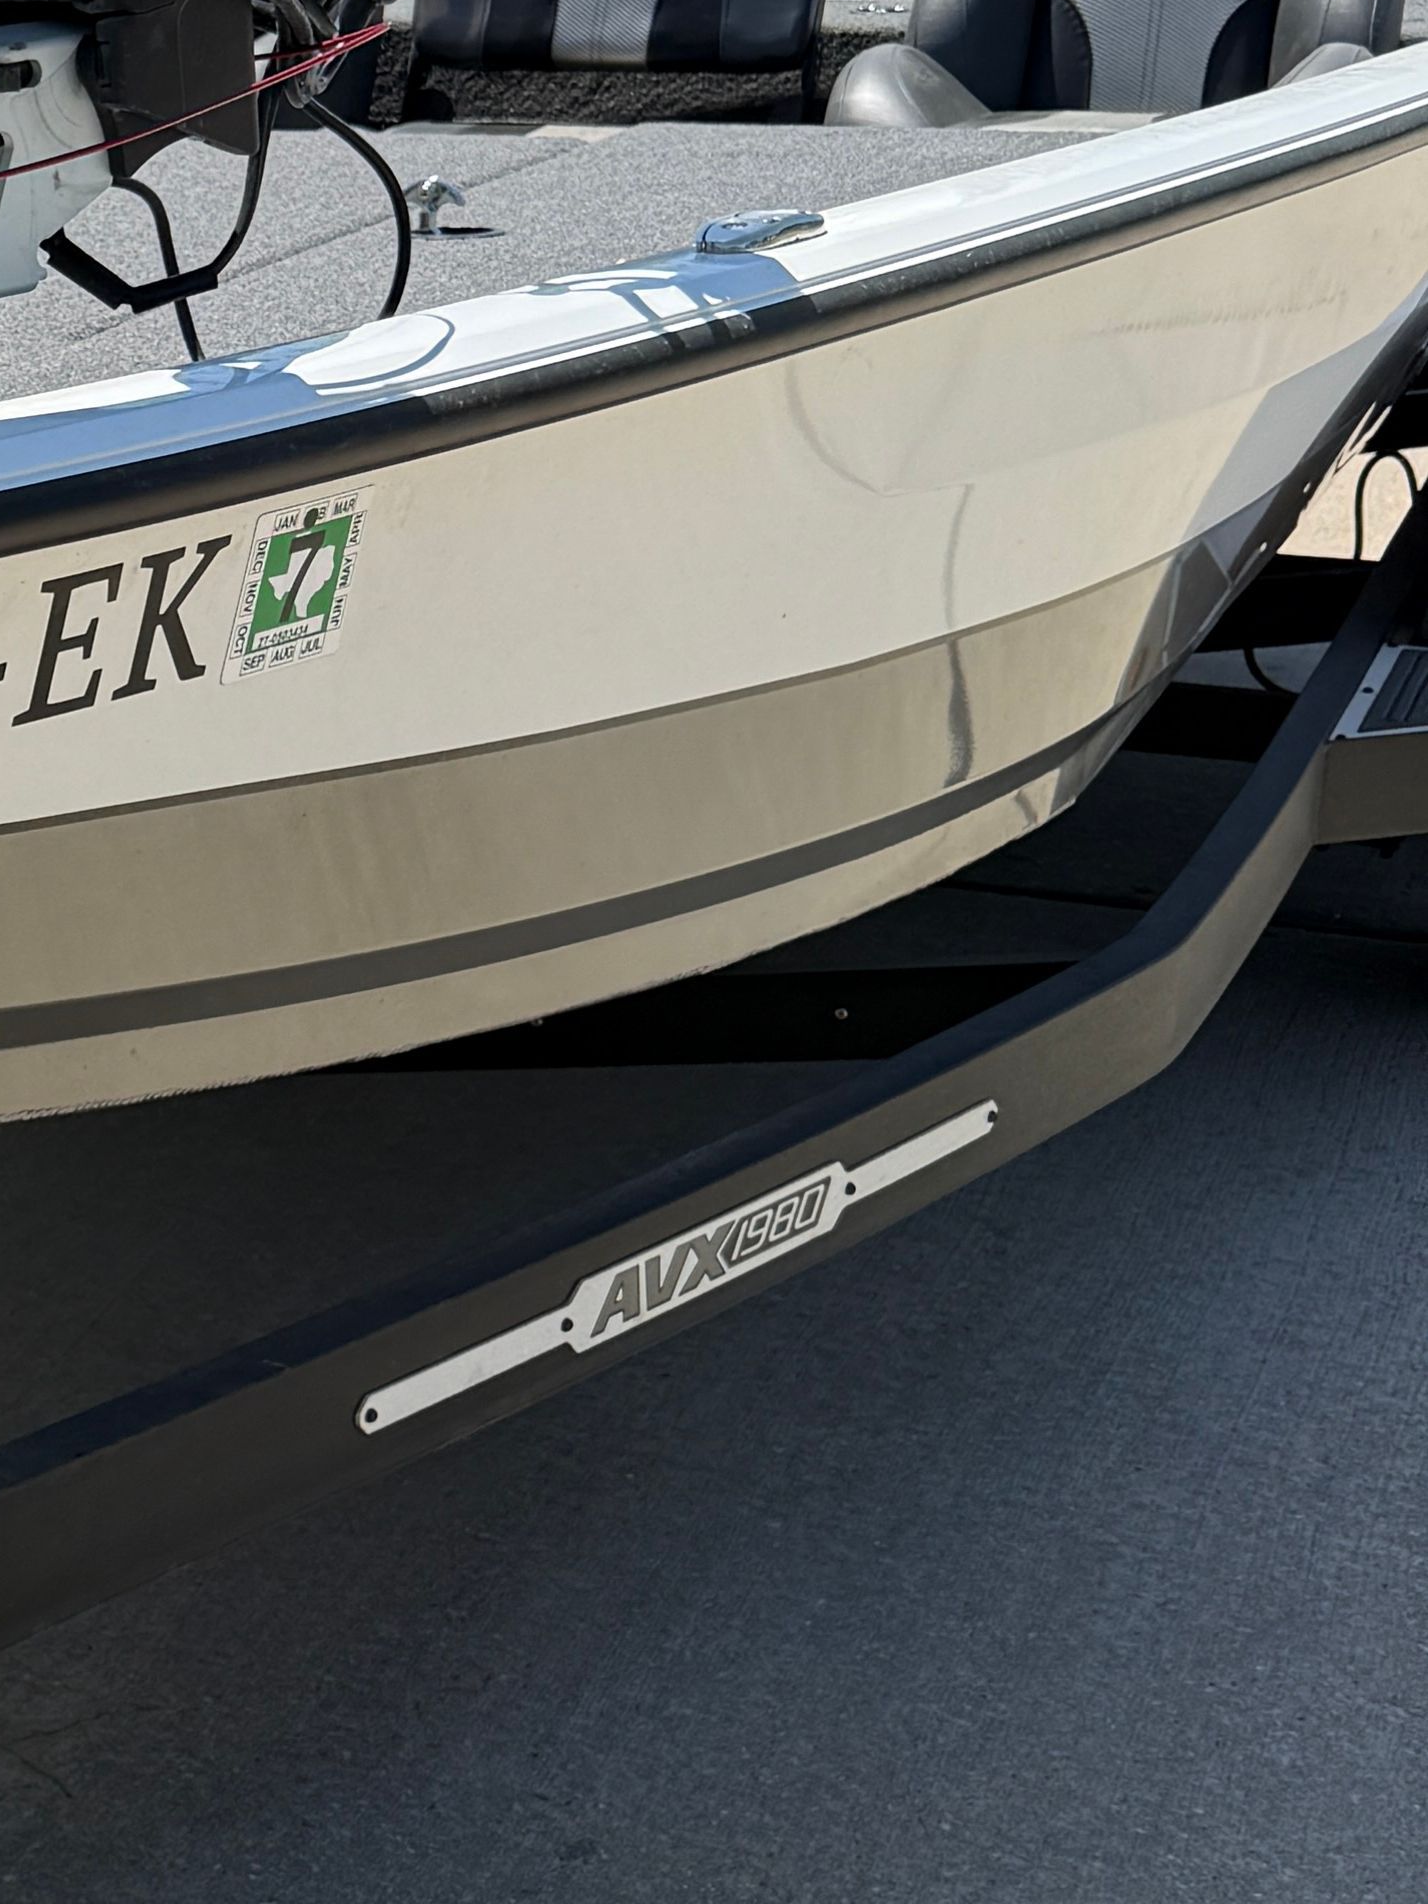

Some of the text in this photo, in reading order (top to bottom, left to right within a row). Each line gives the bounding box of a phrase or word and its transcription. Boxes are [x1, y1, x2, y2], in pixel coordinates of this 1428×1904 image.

[273, 513, 299, 532] JAN
[333, 497, 356, 516] MAR
[349, 512, 363, 545] APR
[252, 540, 268, 574] DEC
[339, 556, 354, 589] MAY
[245, 582, 258, 615] NOV
[330, 597, 344, 628] JUN
[233, 624, 248, 655] OCT
[243, 637, 321, 671] SEP AUG JUL
[590, 1178, 831, 1339] AVX 1980
